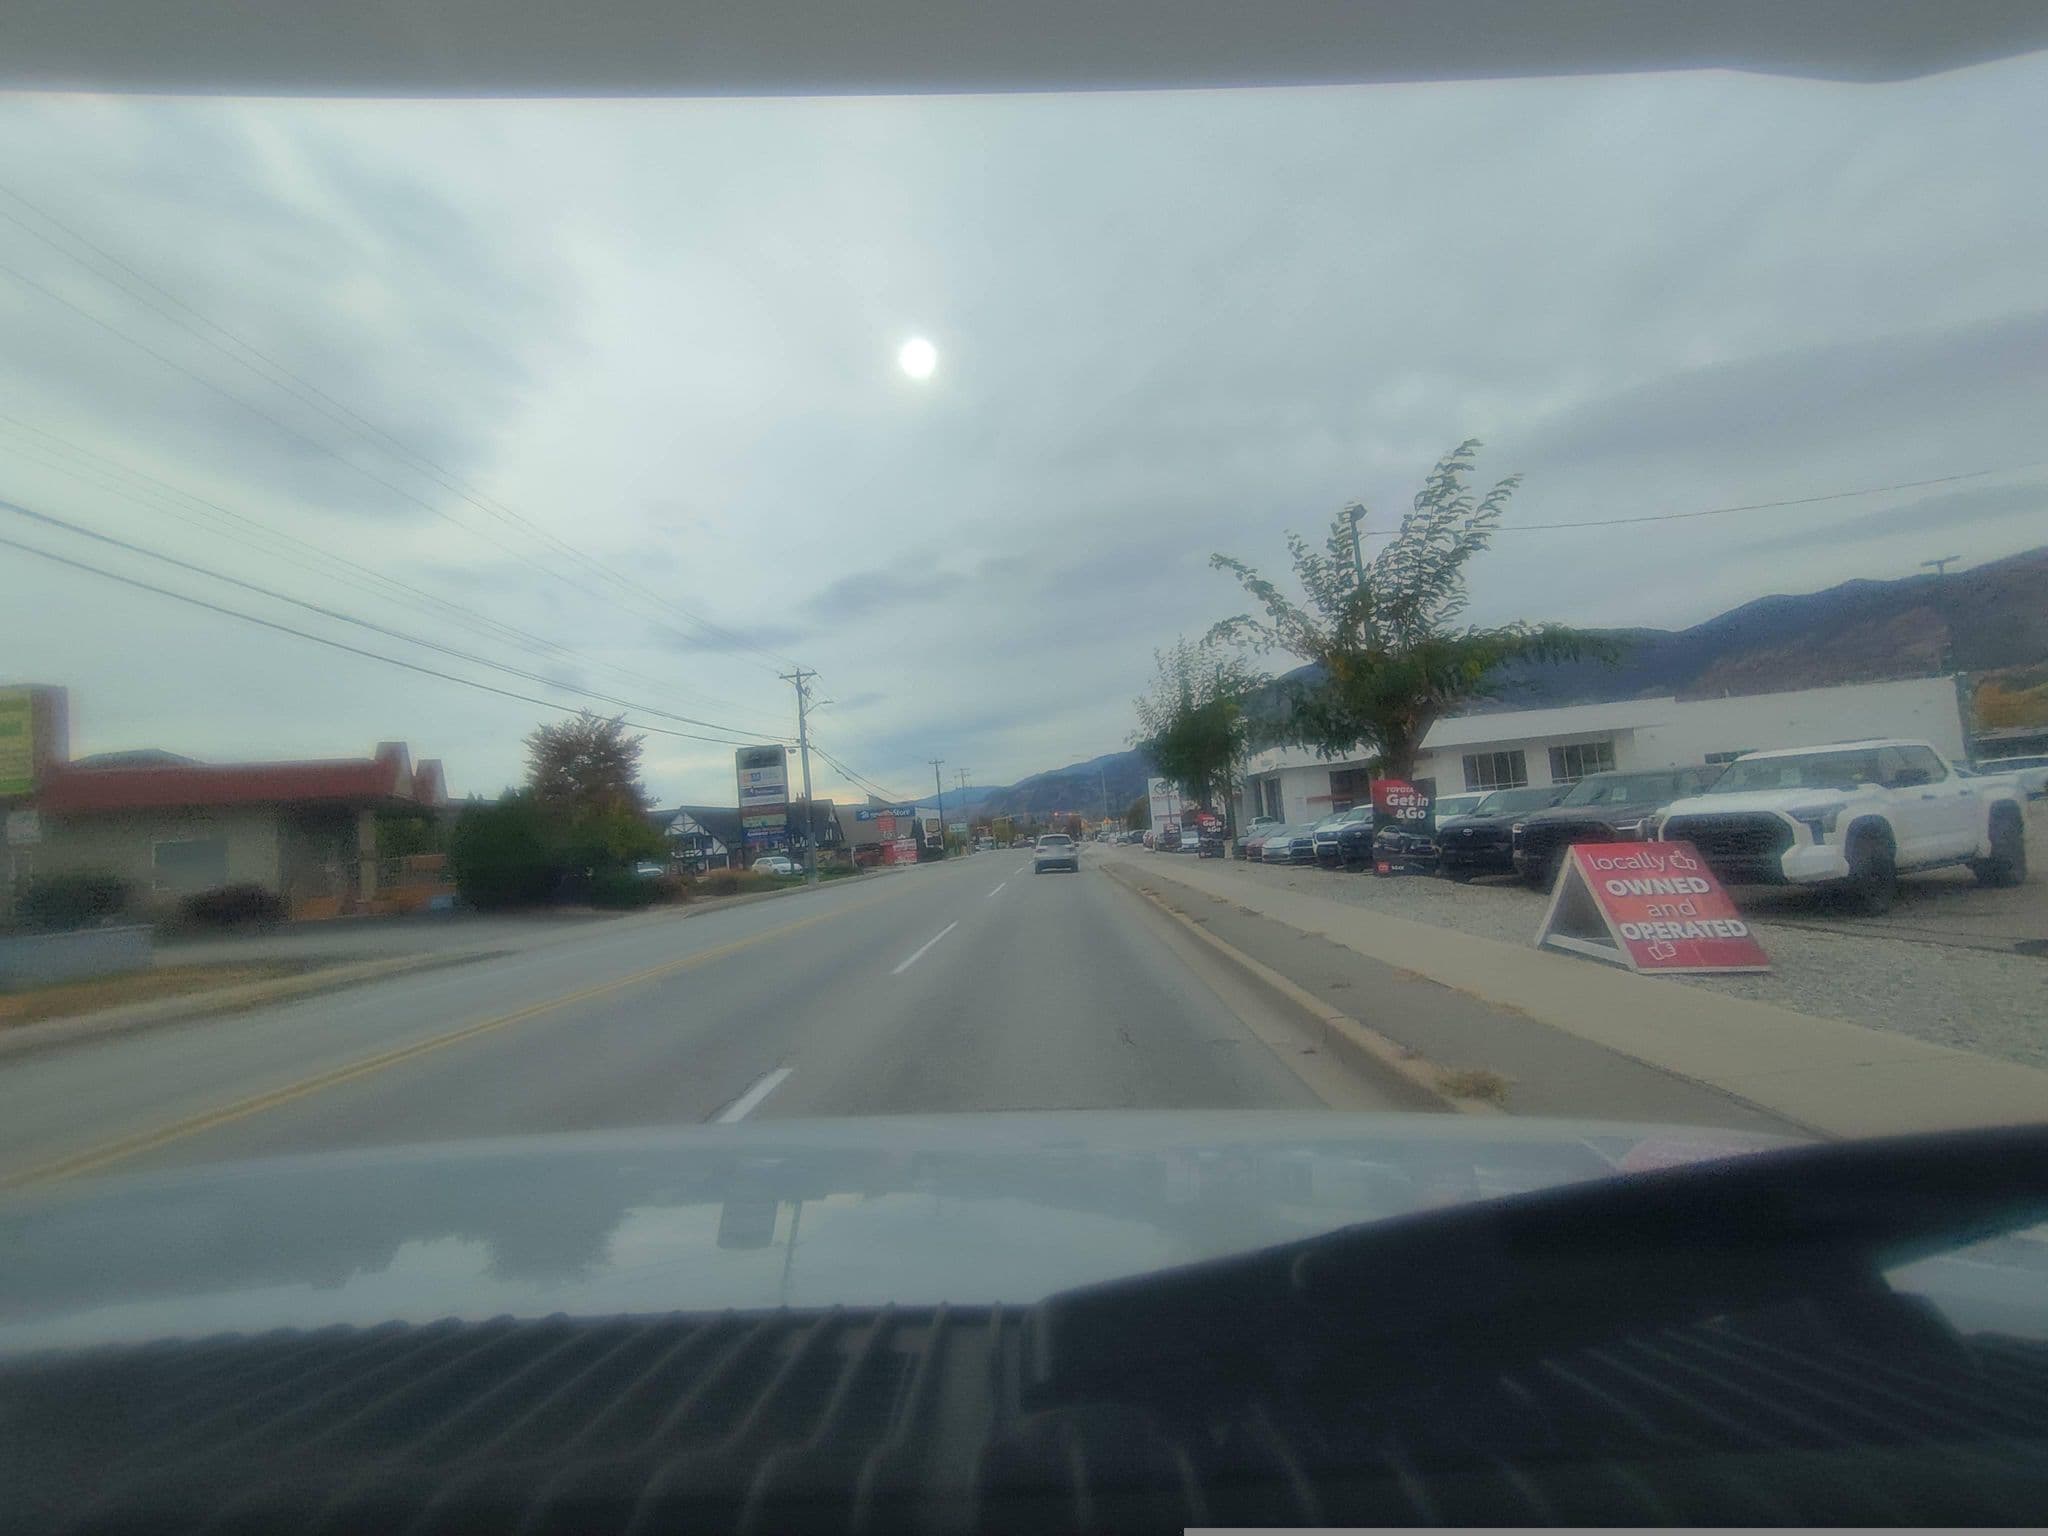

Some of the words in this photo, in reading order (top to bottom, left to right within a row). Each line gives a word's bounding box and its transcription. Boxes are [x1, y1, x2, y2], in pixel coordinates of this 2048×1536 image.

[1386, 794, 1416, 806] Get
[1417, 793, 1429, 807] in
[1588, 852, 1665, 873] locally
[1606, 877, 1709, 896] OWNED
[1646, 899, 1697, 917] and
[1620, 920, 1749, 940] OPERATED
